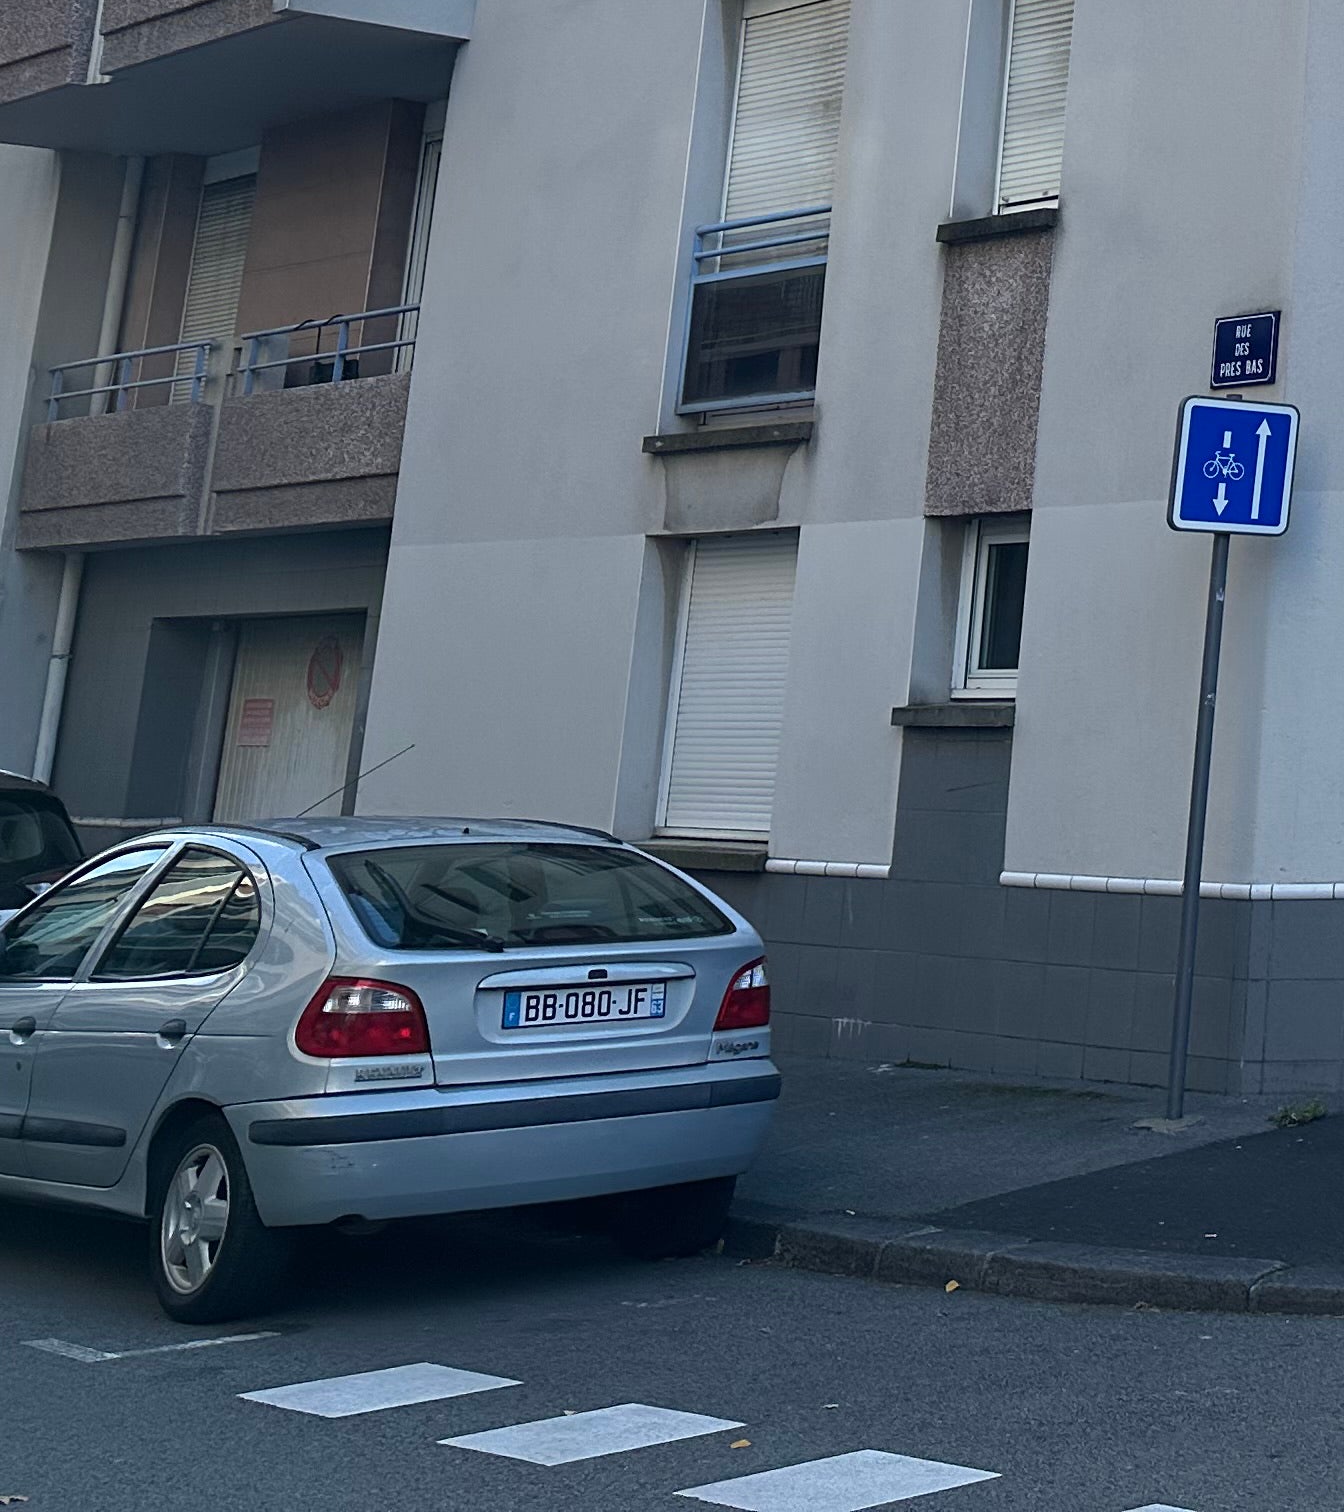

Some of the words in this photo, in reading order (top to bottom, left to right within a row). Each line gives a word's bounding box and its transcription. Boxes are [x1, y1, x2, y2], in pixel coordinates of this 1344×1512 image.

[1235, 324, 1252, 339] RUE
[1234, 342, 1250, 357] DES
[1245, 358, 1264, 375] BAS
[524, 987, 648, 1022] BB-080-JF
